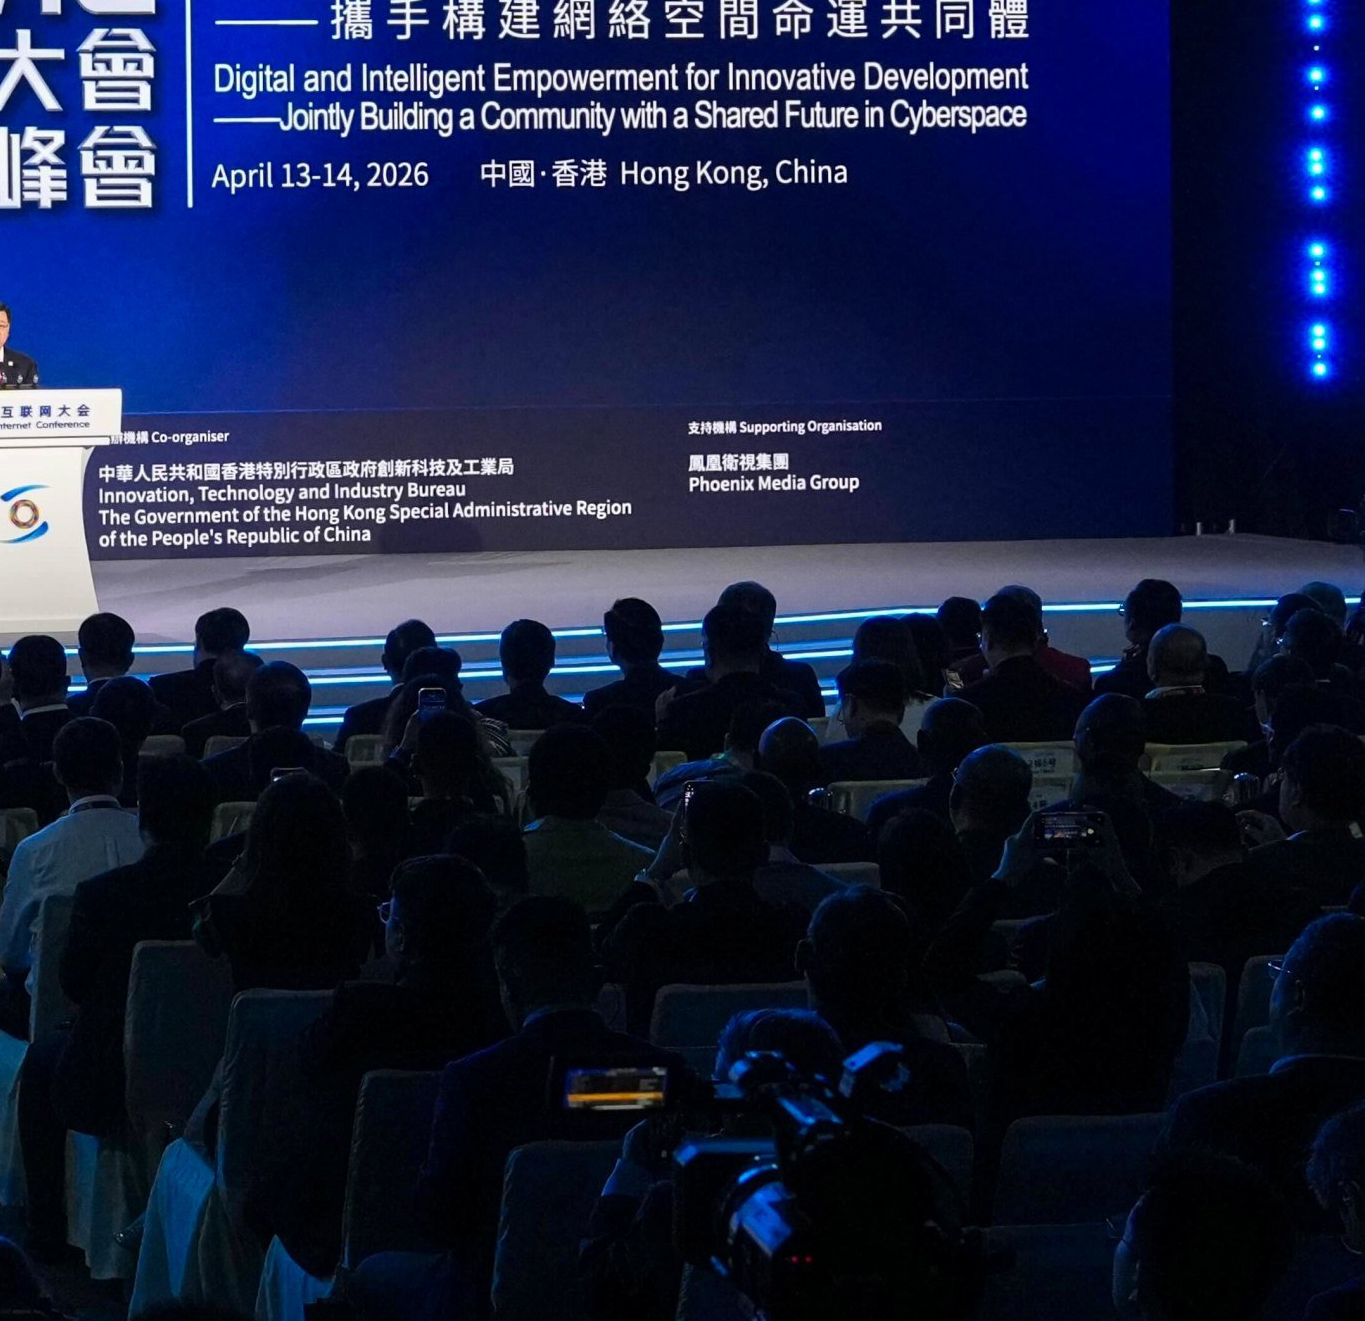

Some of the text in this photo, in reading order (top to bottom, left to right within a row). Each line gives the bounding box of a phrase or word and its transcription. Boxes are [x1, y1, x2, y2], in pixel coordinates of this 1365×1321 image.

[215, 62, 1028, 98] Digital and Intelligent Empowerment for Innovative Development
[361, 102, 453, 137] Building
[460, 108, 474, 129] a
[481, 101, 615, 136] Community
[621, 101, 666, 128] with
[673, 107, 688, 128] a
[695, 100, 778, 128] Shared
[786, 100, 858, 128] Future
[865, 100, 883, 127] in
[891, 99, 1027, 134] Cyberspace
[212, 162, 428, 193] April 13-14, 2026
[622, 161, 689, 191] Hong
[697, 161, 768, 191] Kong,
[776, 158, 847, 183] China
[152, 430, 229, 445] Co-organiser
[740, 421, 805, 435] Supporting
[808, 420, 882, 434] Organisation
[99, 458, 514, 482] 中華人民共和國香港特別行政區政府創新科技及工業局
[100, 482, 465, 504] Innovation, Technology and Industry Bureau
[690, 474, 859, 492] Phoenix Media Group
[99, 500, 631, 525] The Government of the Hong Kong Special Administrative Region
[99, 526, 370, 549] of the People's Republic of China
